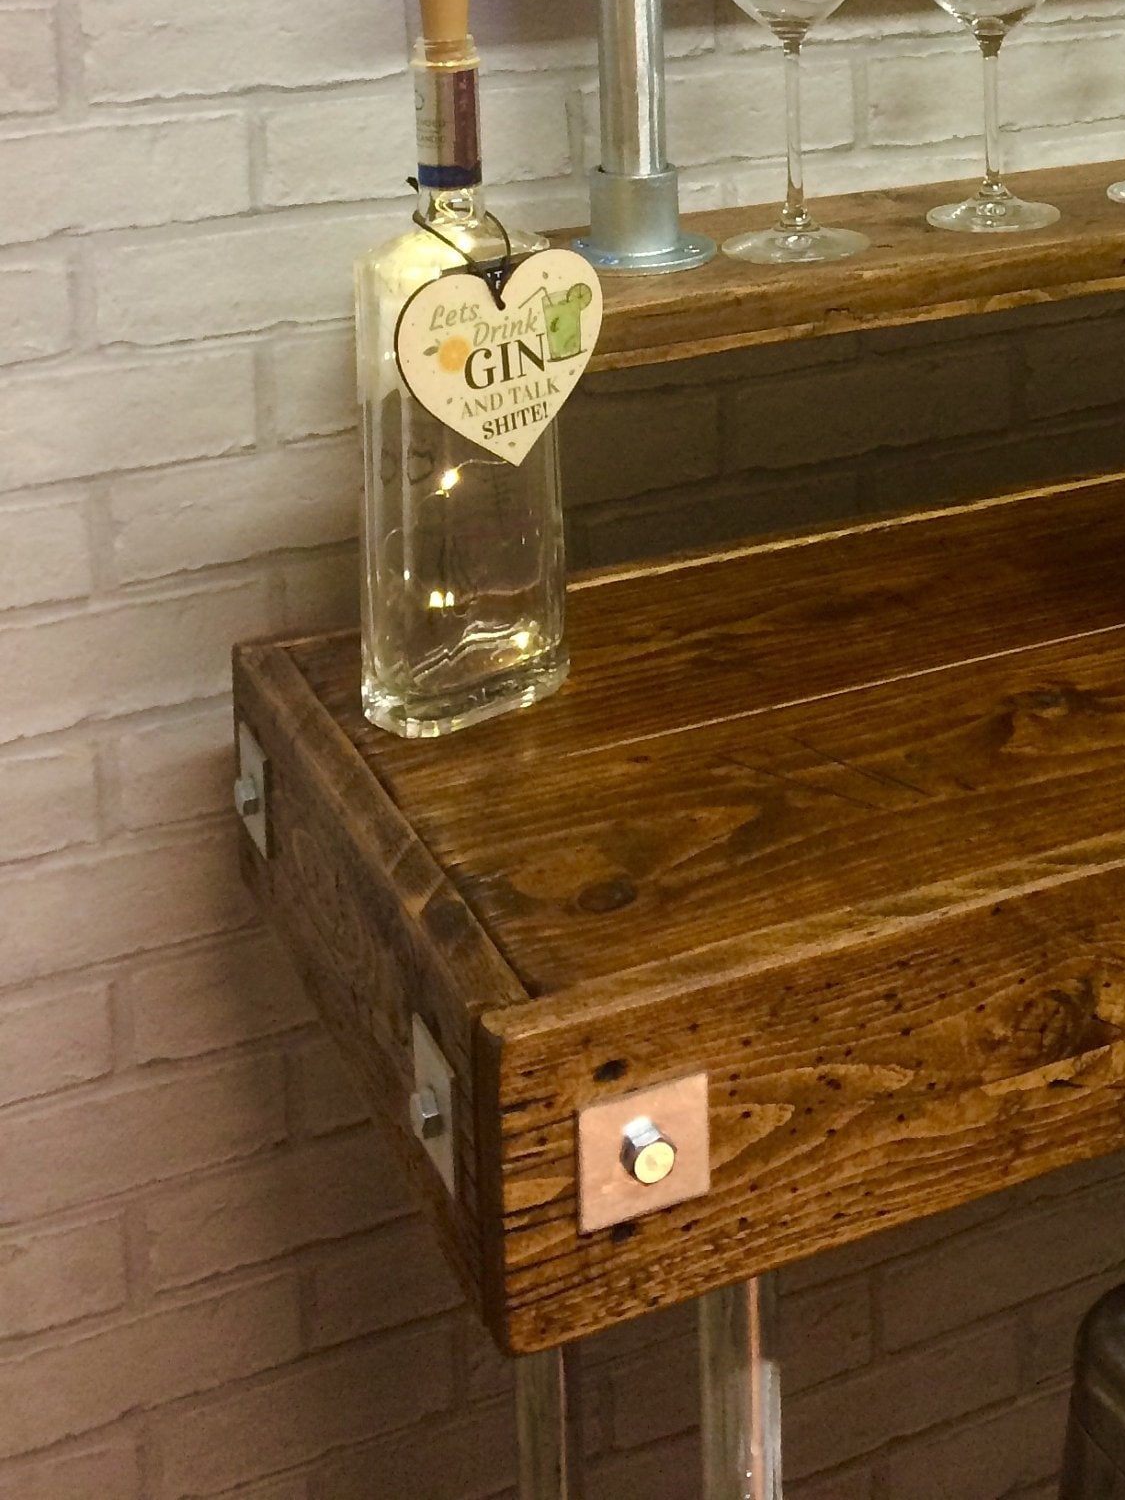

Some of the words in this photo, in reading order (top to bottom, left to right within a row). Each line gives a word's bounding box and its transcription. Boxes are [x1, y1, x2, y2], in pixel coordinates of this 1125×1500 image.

[429, 301, 480, 332] Lets
[472, 307, 538, 347] Drink
[464, 332, 546, 390] GIN
[460, 391, 504, 420] AND
[507, 377, 561, 406] TALK
[481, 400, 549, 440] SHITE!
